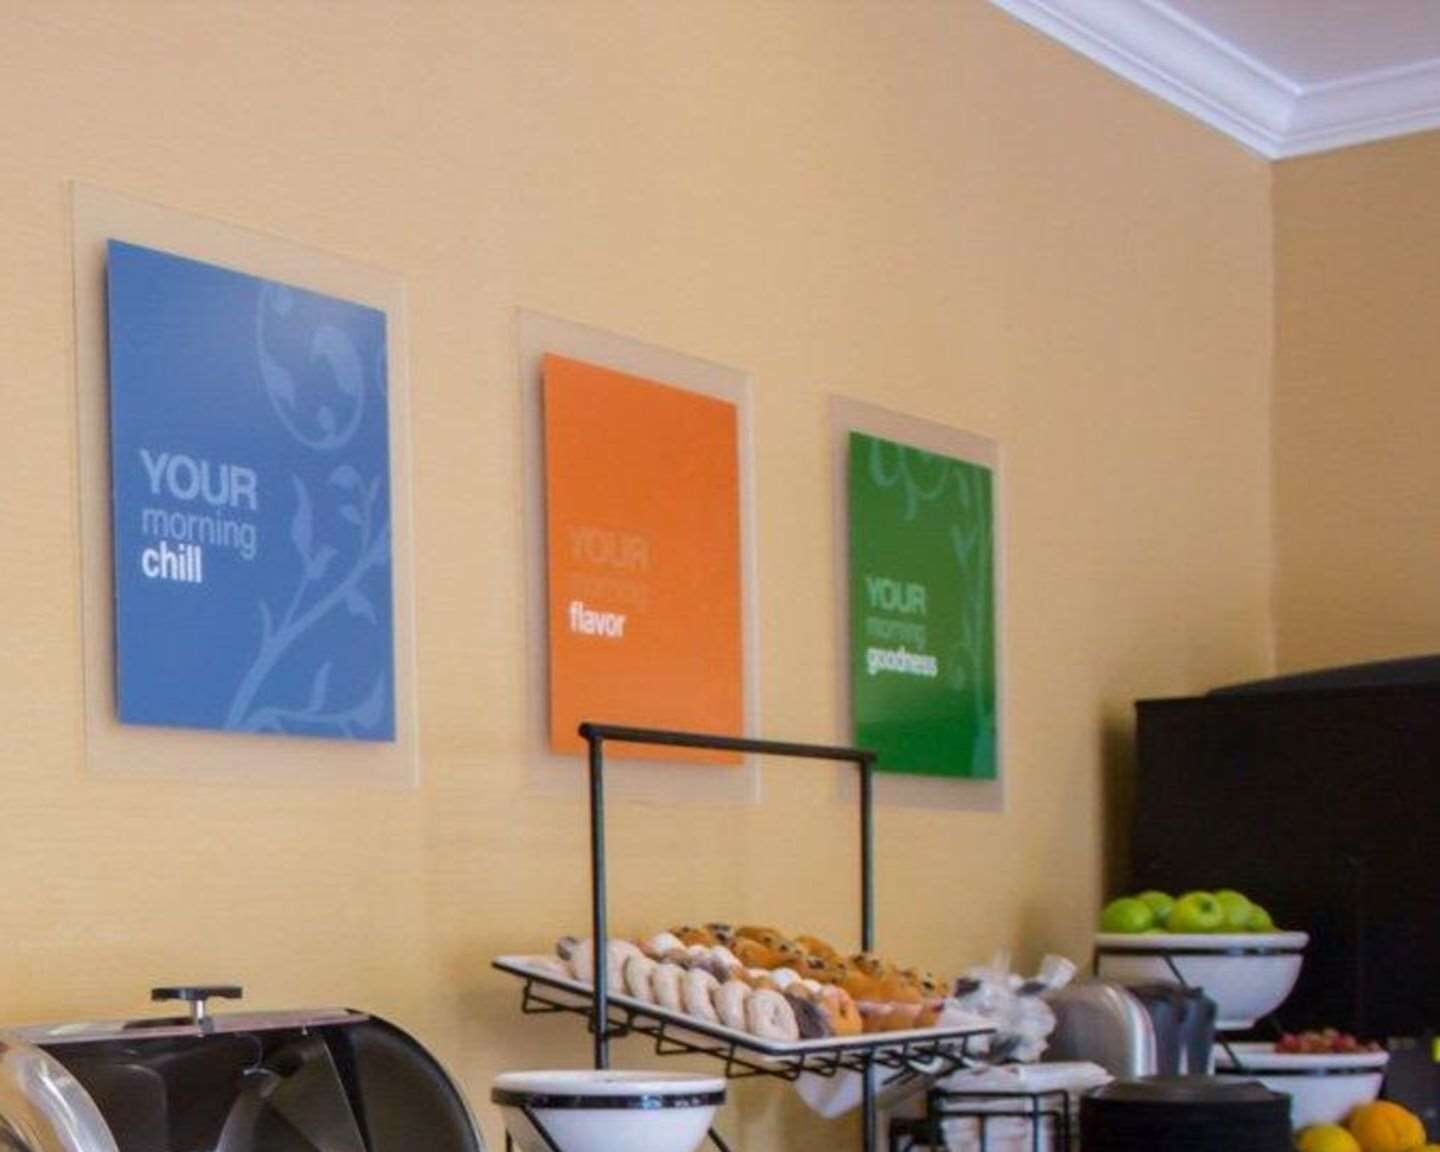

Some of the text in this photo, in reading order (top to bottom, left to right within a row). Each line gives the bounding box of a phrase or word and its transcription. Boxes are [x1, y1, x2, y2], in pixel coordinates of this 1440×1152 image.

[139, 449, 258, 511] YOUR
[141, 508, 258, 560] morning
[141, 541, 203, 583] chill
[866, 577, 927, 614] YOUR
[570, 600, 626, 637] flavor
[867, 646, 938, 677] goodness
